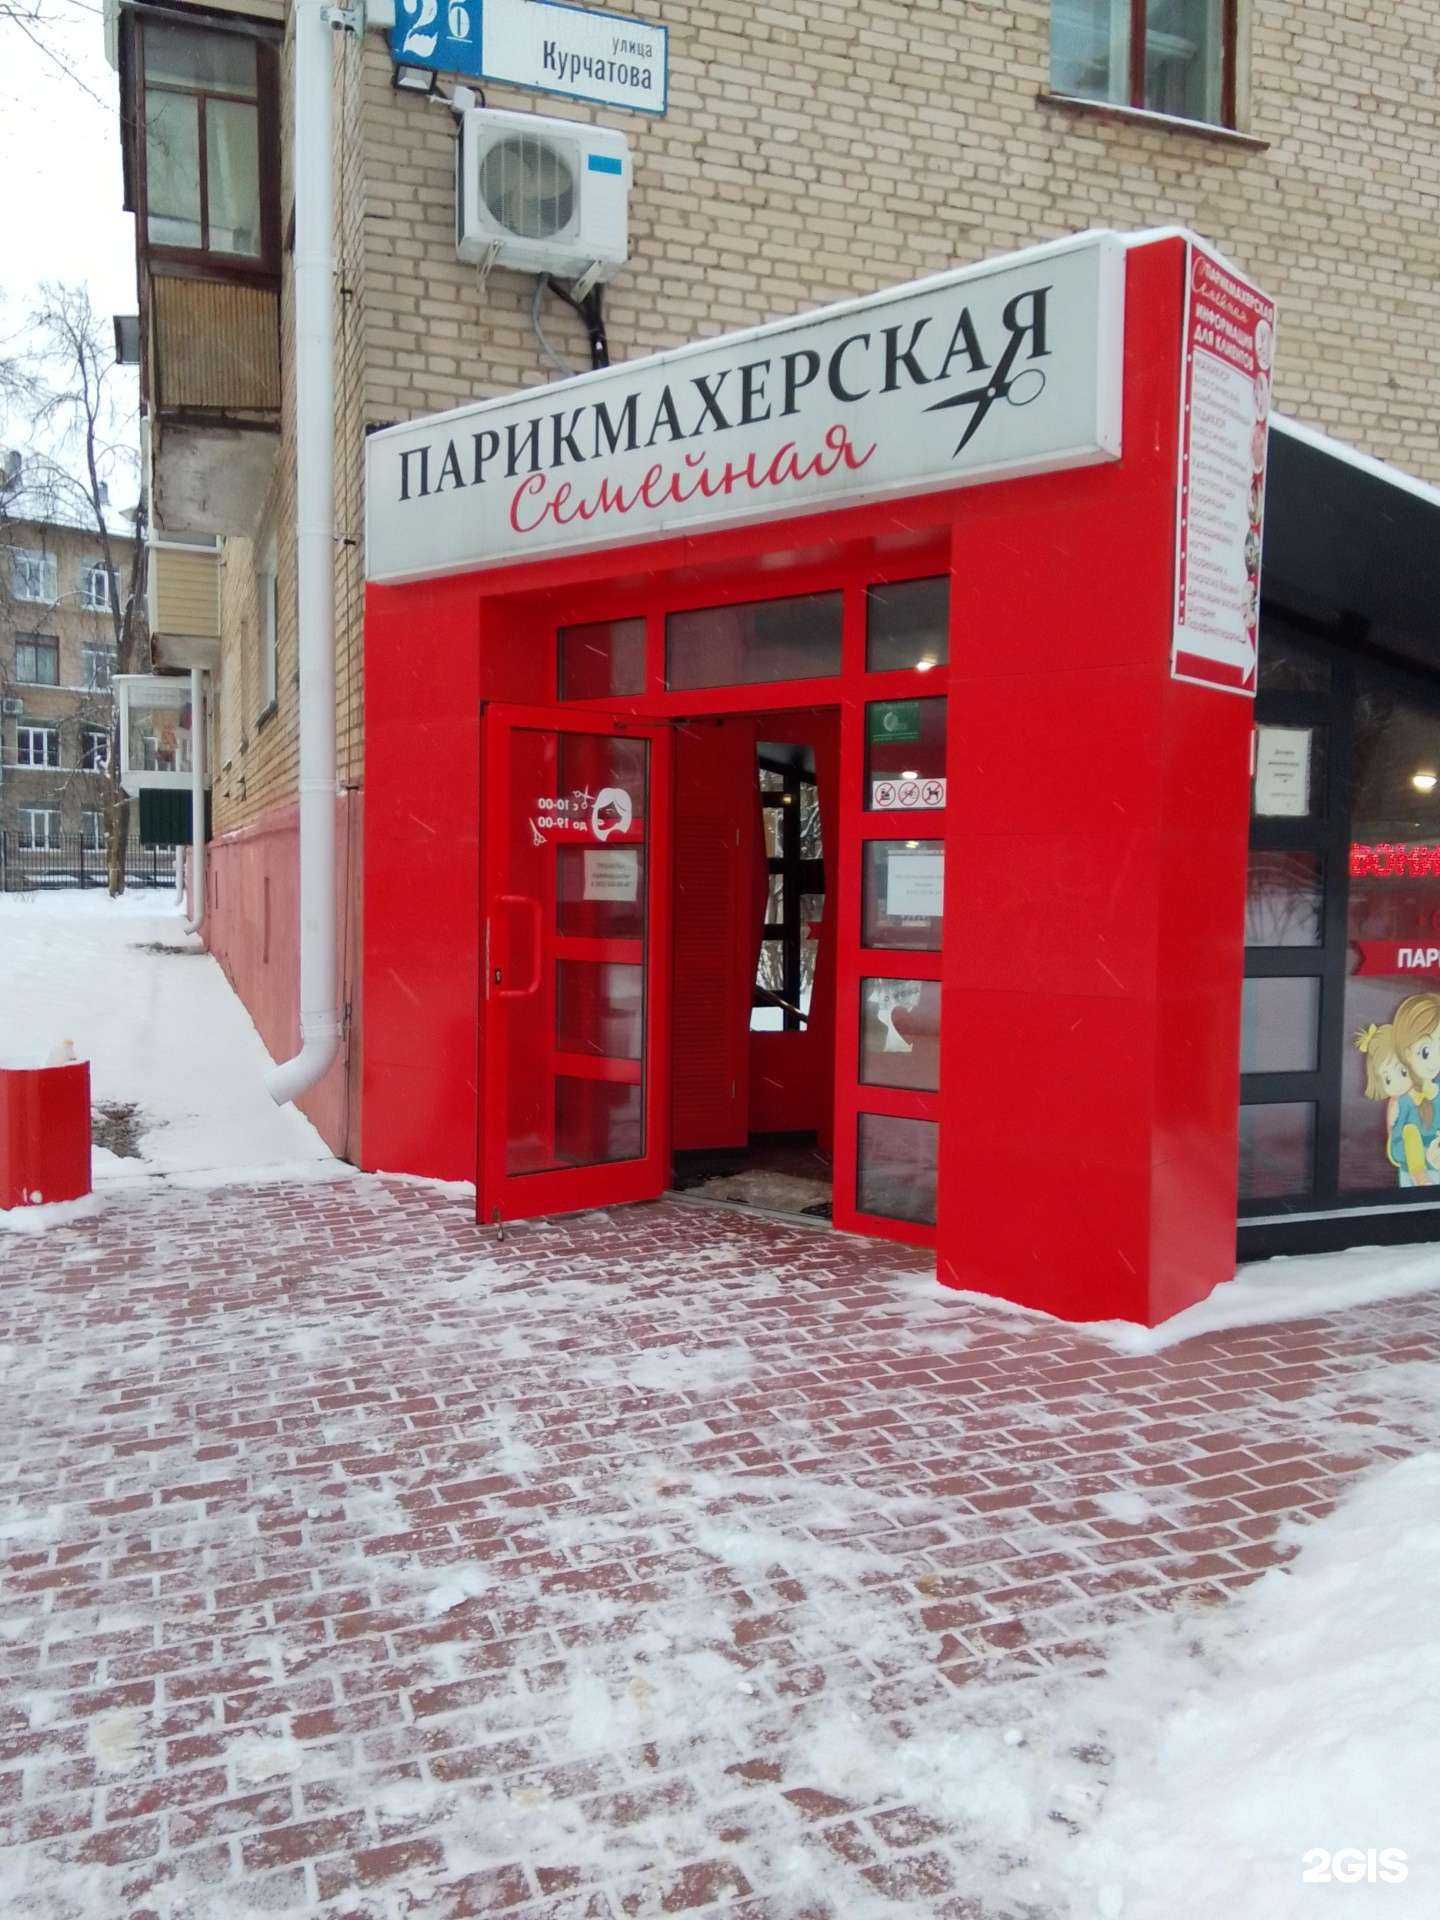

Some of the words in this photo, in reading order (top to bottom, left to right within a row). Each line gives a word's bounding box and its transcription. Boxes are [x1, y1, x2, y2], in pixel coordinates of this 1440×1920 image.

[543, 40, 653, 90] Курчатова
[612, 37, 653, 57] улица
[399, 285, 1054, 502] ПАРИКМАХЕРСКАЯ
[510, 423, 878, 533] Семейная
[1398, 948, 1440, 968] ПАР
